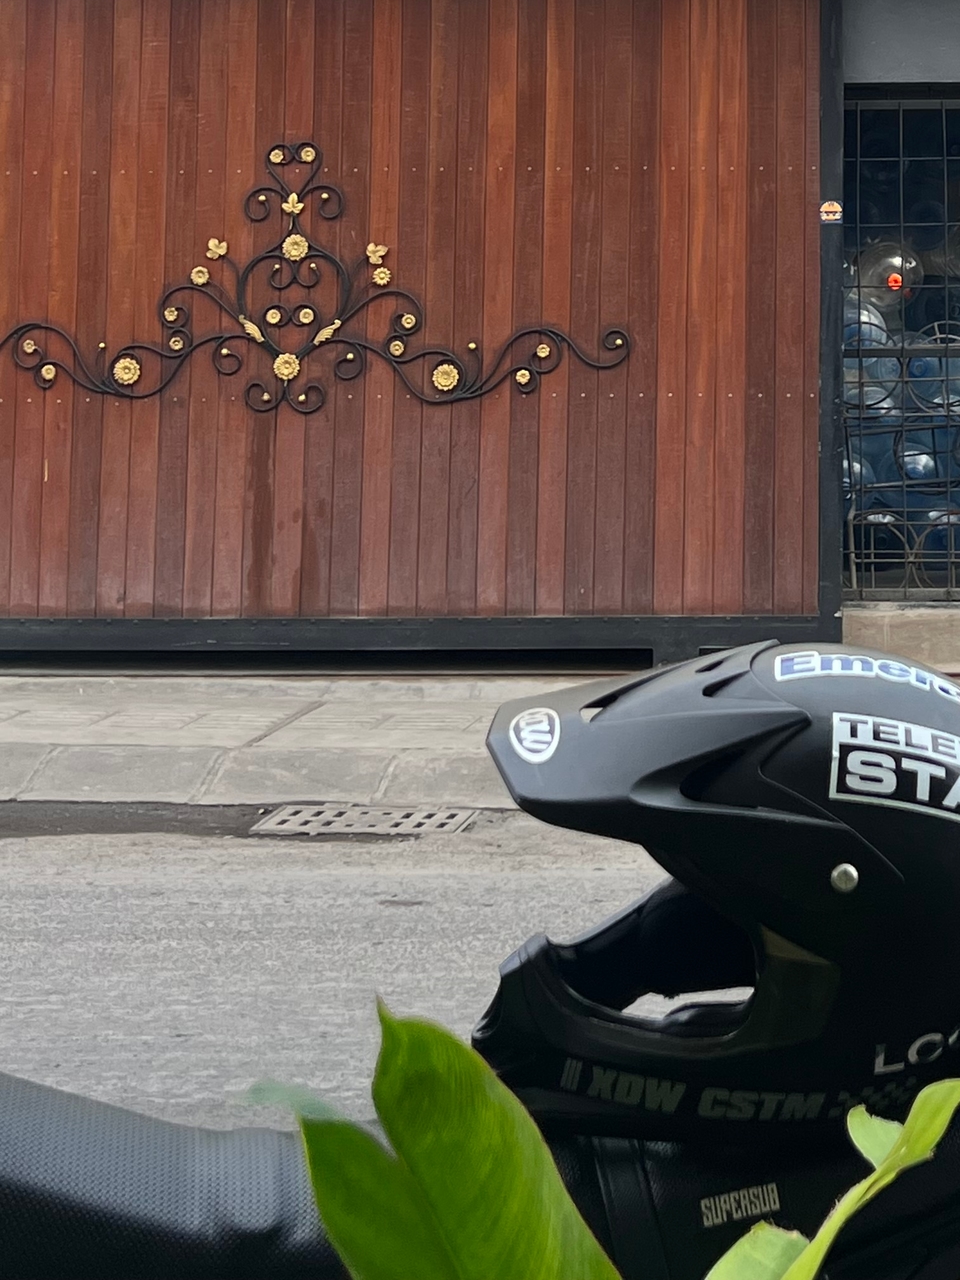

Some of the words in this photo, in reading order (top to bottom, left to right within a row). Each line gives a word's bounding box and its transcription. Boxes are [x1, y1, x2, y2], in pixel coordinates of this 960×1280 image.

[586, 1065, 687, 1114] XDW
[697, 1086, 827, 1120] CSTM
[700, 1182, 781, 1228] SUPERSUB
